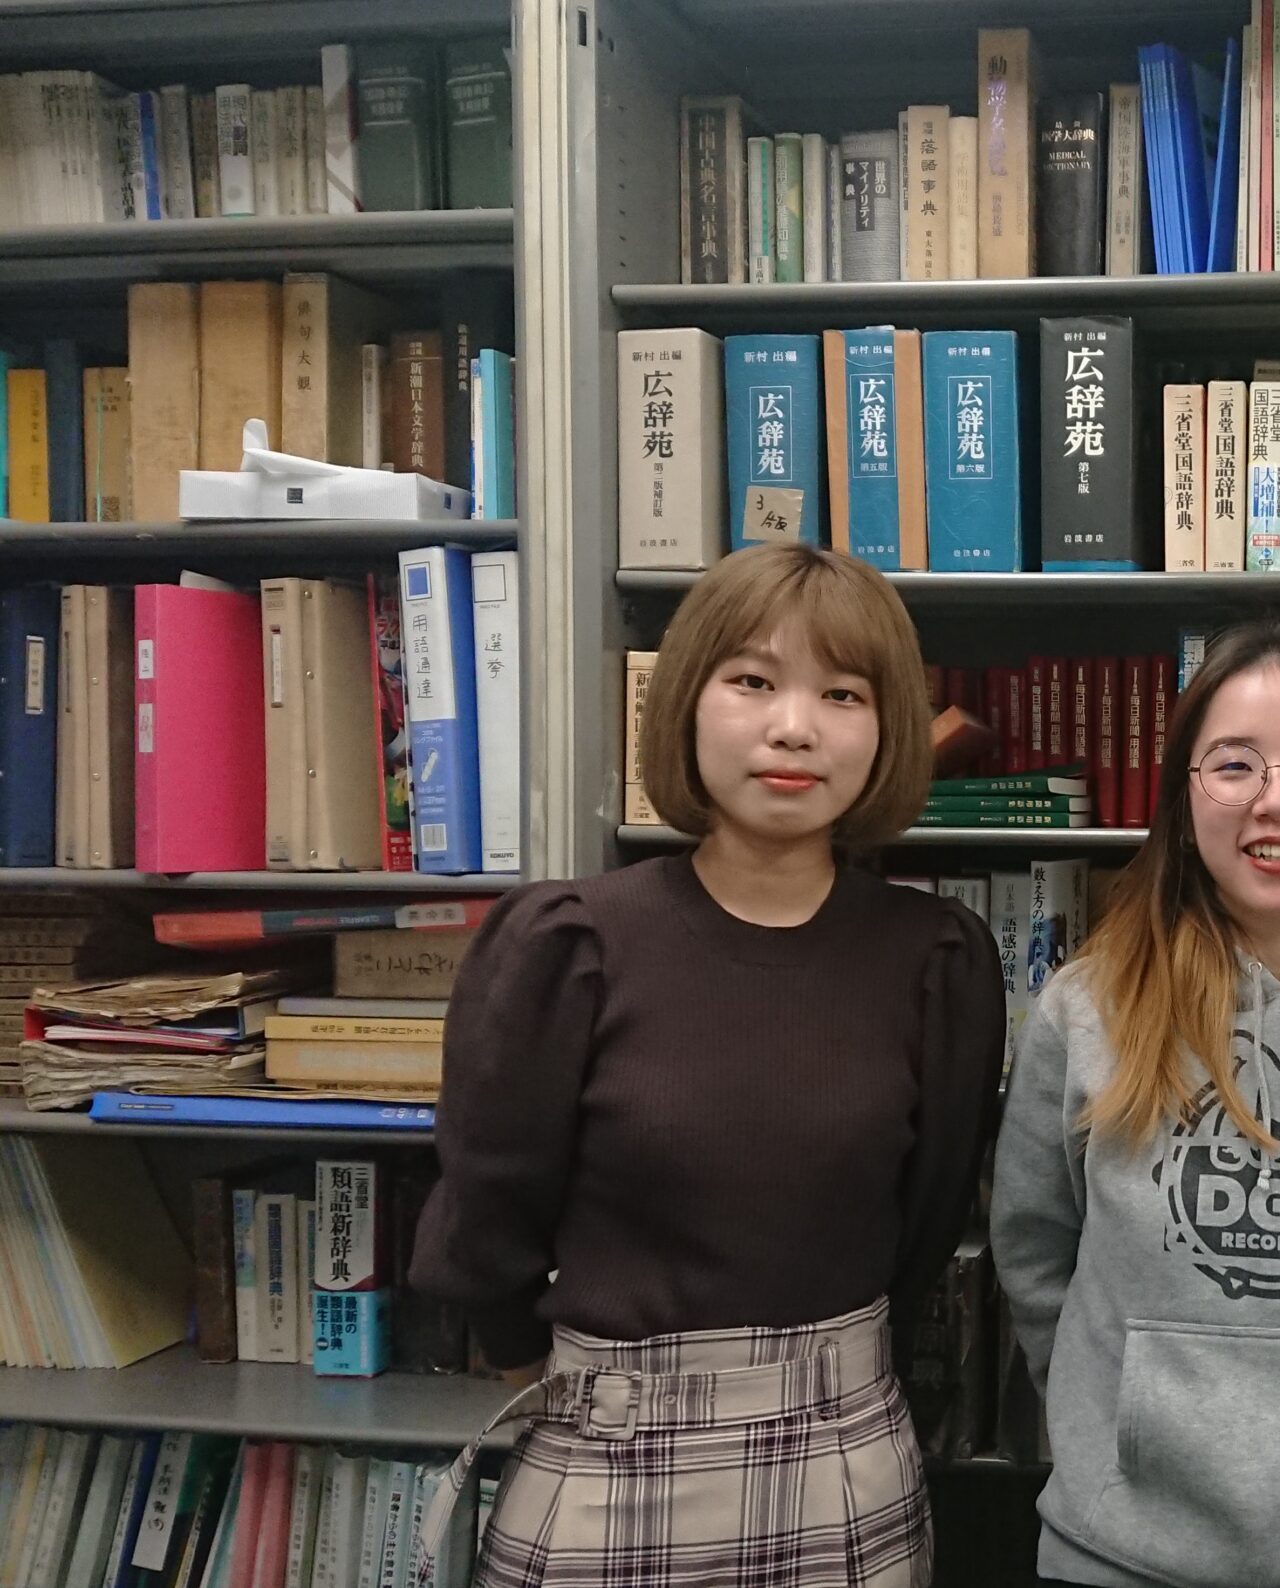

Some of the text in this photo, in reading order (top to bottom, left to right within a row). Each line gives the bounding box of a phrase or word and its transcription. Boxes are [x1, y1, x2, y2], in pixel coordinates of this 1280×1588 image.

[874, 159, 887, 194] 世界の
[921, 138, 937, 216] 落語事典
[1050, 151, 1086, 160] MEDICAL
[859, 161, 870, 226] マイノリティ
[409, 362, 423, 467] 新潮日本文学辞典
[642, 370, 674, 459] 広辞苑
[757, 393, 785, 475] 広辞苑
[859, 379, 888, 457] 広辞苑
[957, 381, 984, 459] 広辞苑
[1064, 348, 1105, 457] 広辞苑
[1253, 389, 1269, 461] 国語辞典
[653, 463, 663, 517] 第二版補訂版
[860, 463, 888, 472] 第五版
[956, 464, 985, 473] 第六版
[1078, 462, 1089, 494] 第七版
[1175, 395, 1194, 531] 三省堂国語辞典
[1215, 387, 1235, 520] 三省堂国語辞典
[1064, 534, 1103, 543] 岩波書店
[413, 614, 433, 699] 用語通達
[485, 633, 504, 679] 選挙
[1032, 867, 1046, 950] 数え方の辞典
[1002, 917, 1016, 993] 語感の辞典
[330, 1167, 352, 1282] 類語新辞典
[355, 1168, 369, 1208] 三省堂
[331, 1296, 343, 1350] 類語辞典
[345, 1296, 357, 1334] 最新の
